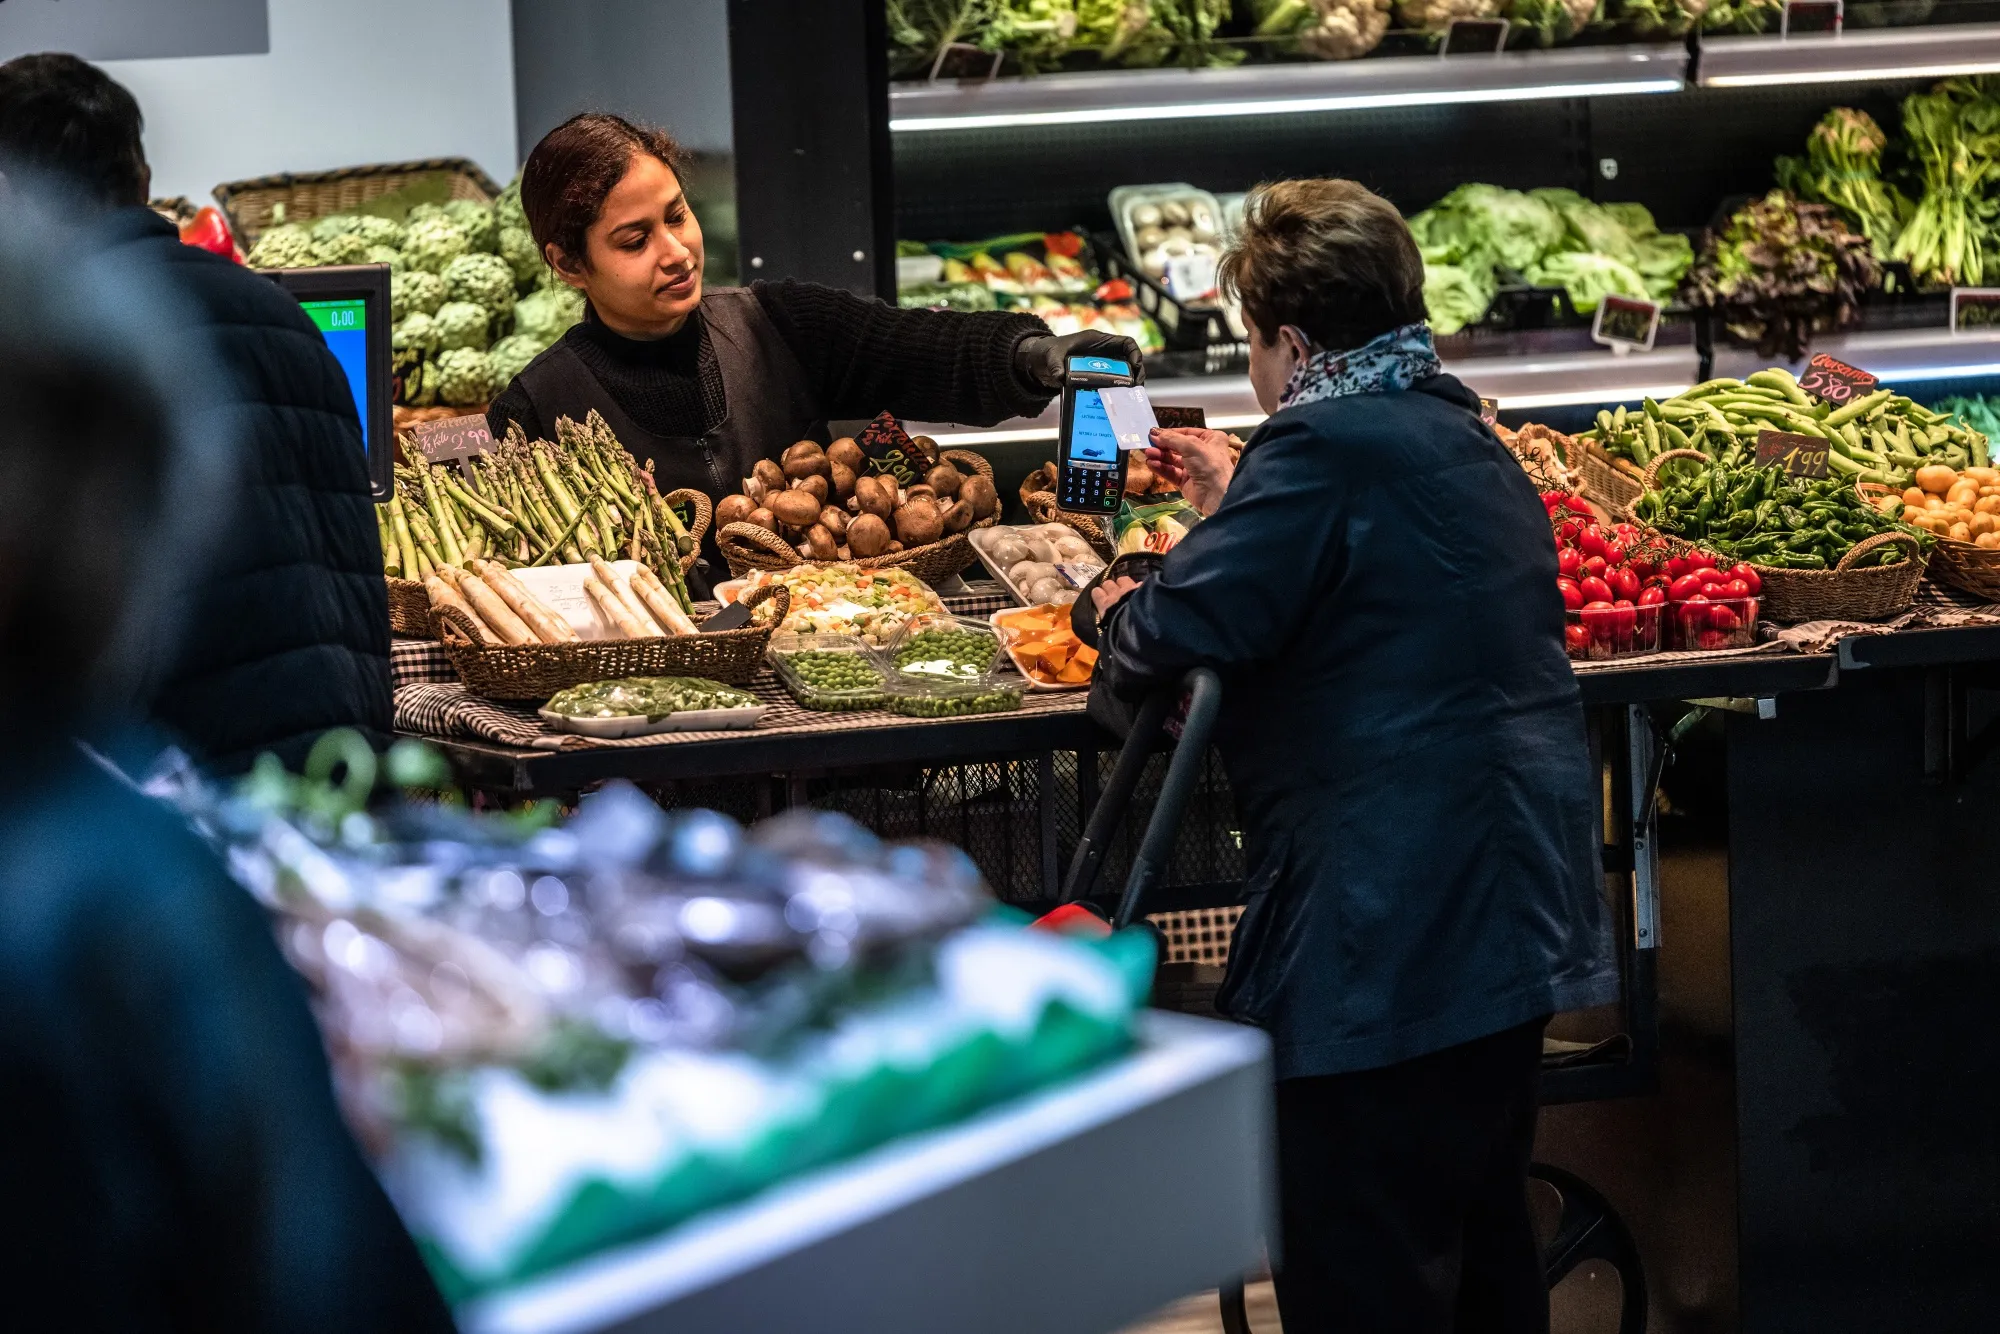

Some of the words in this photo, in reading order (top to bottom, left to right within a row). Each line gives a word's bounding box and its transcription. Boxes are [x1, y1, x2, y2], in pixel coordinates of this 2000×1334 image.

[331, 310, 354, 327] 0,00
[451, 428, 490, 451] 2'99
[1782, 446, 1828, 476] 1'99
